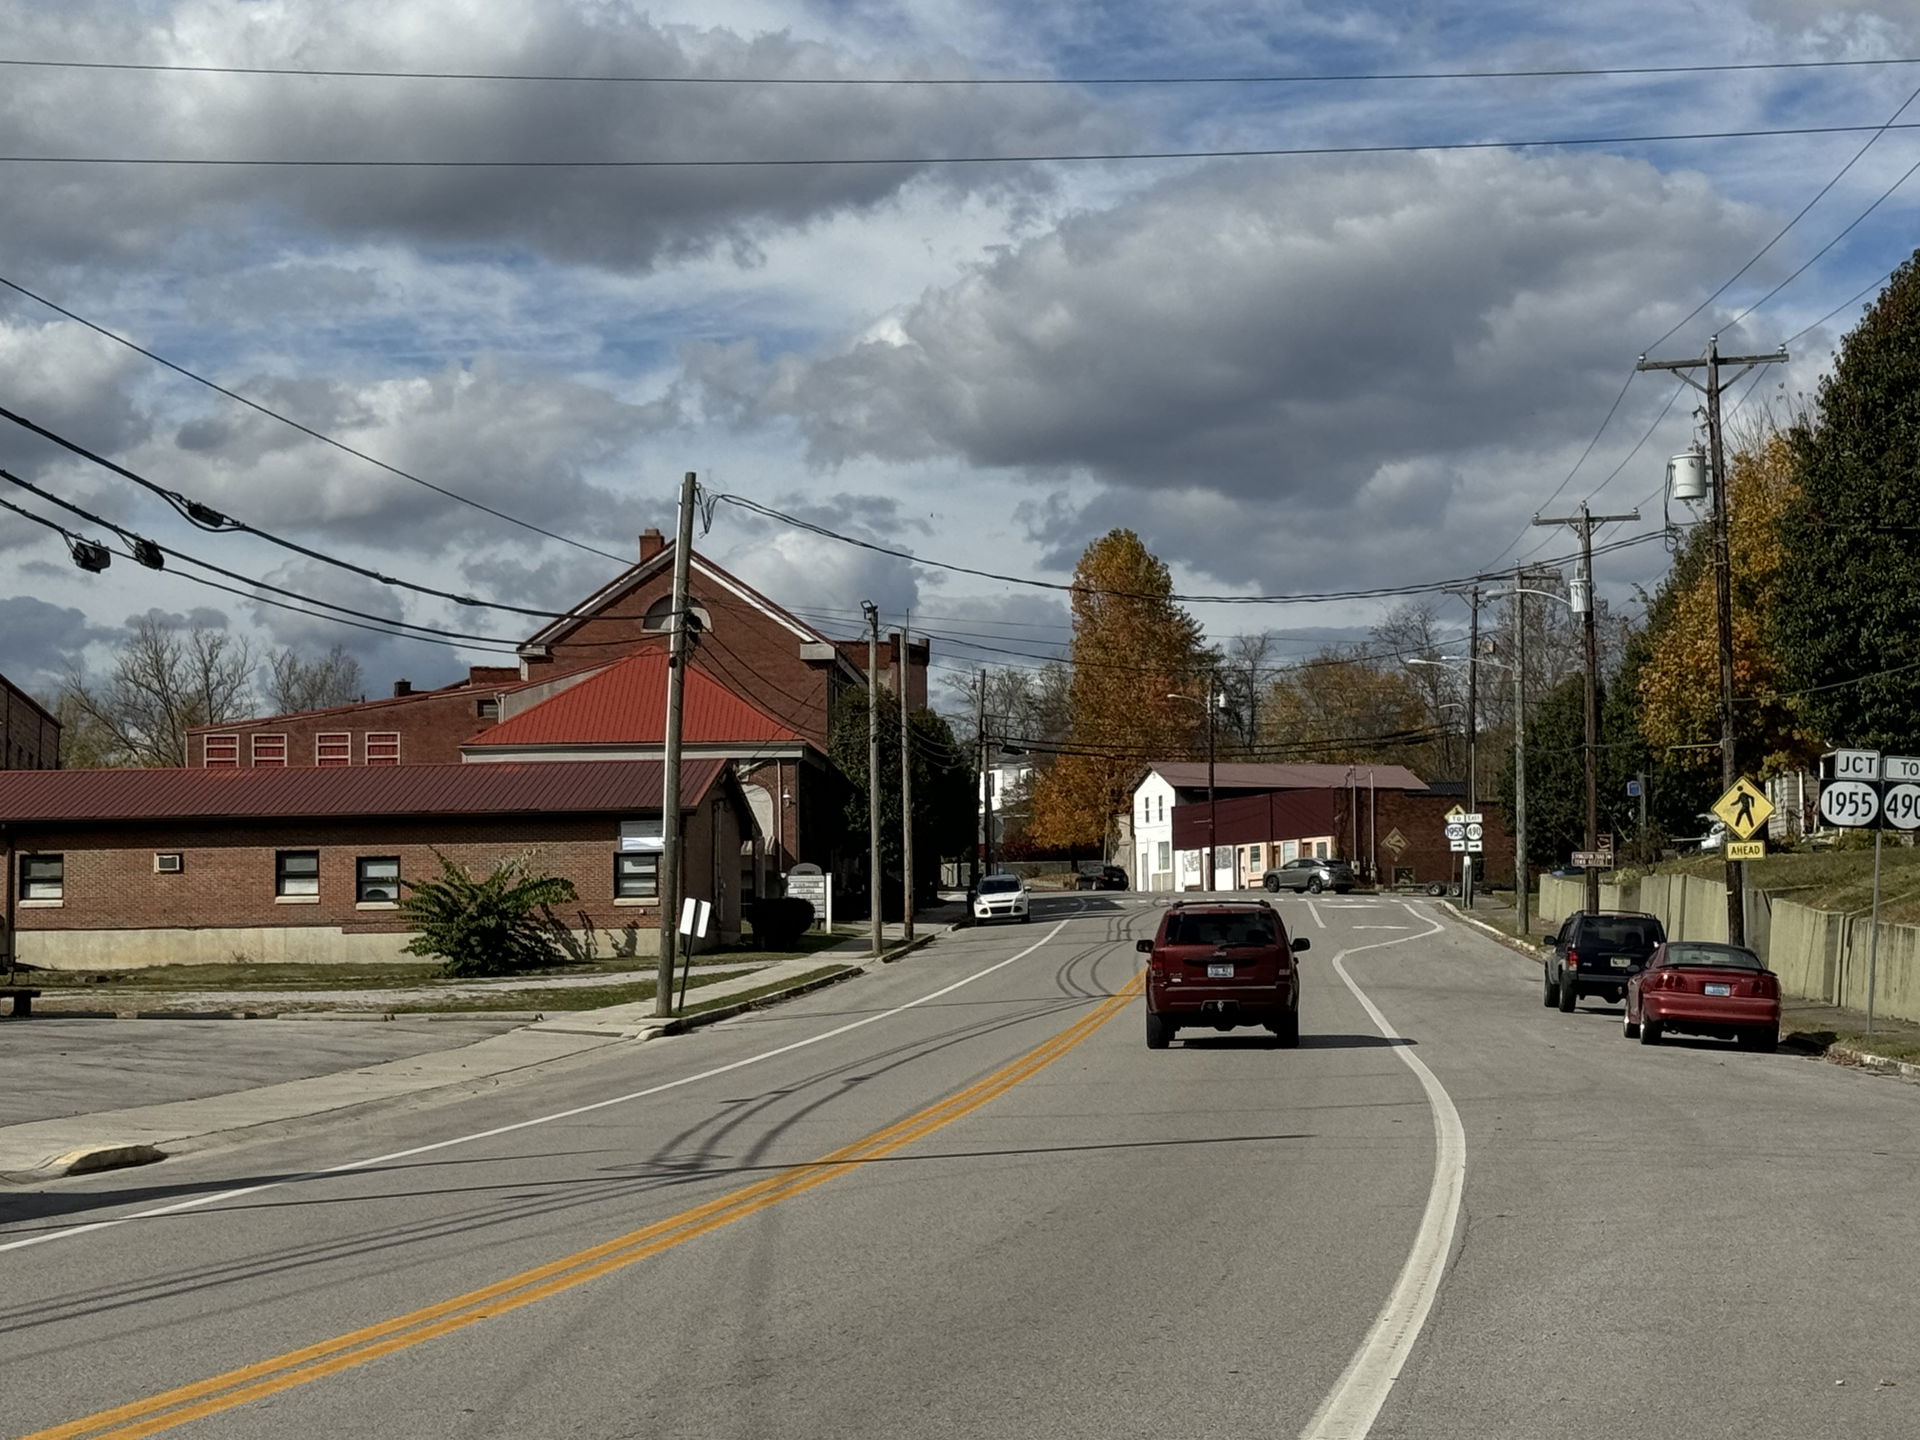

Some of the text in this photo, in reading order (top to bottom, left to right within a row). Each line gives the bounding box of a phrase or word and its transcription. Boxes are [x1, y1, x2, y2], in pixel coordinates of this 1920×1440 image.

[1839, 756, 1876, 774] JCT
[1900, 762, 1919, 776] TO
[1827, 790, 1872, 817] 1955
[1446, 826, 1464, 837] 1955
[1467, 826, 1481, 837] 490
[1731, 845, 1760, 855] AHEAD
